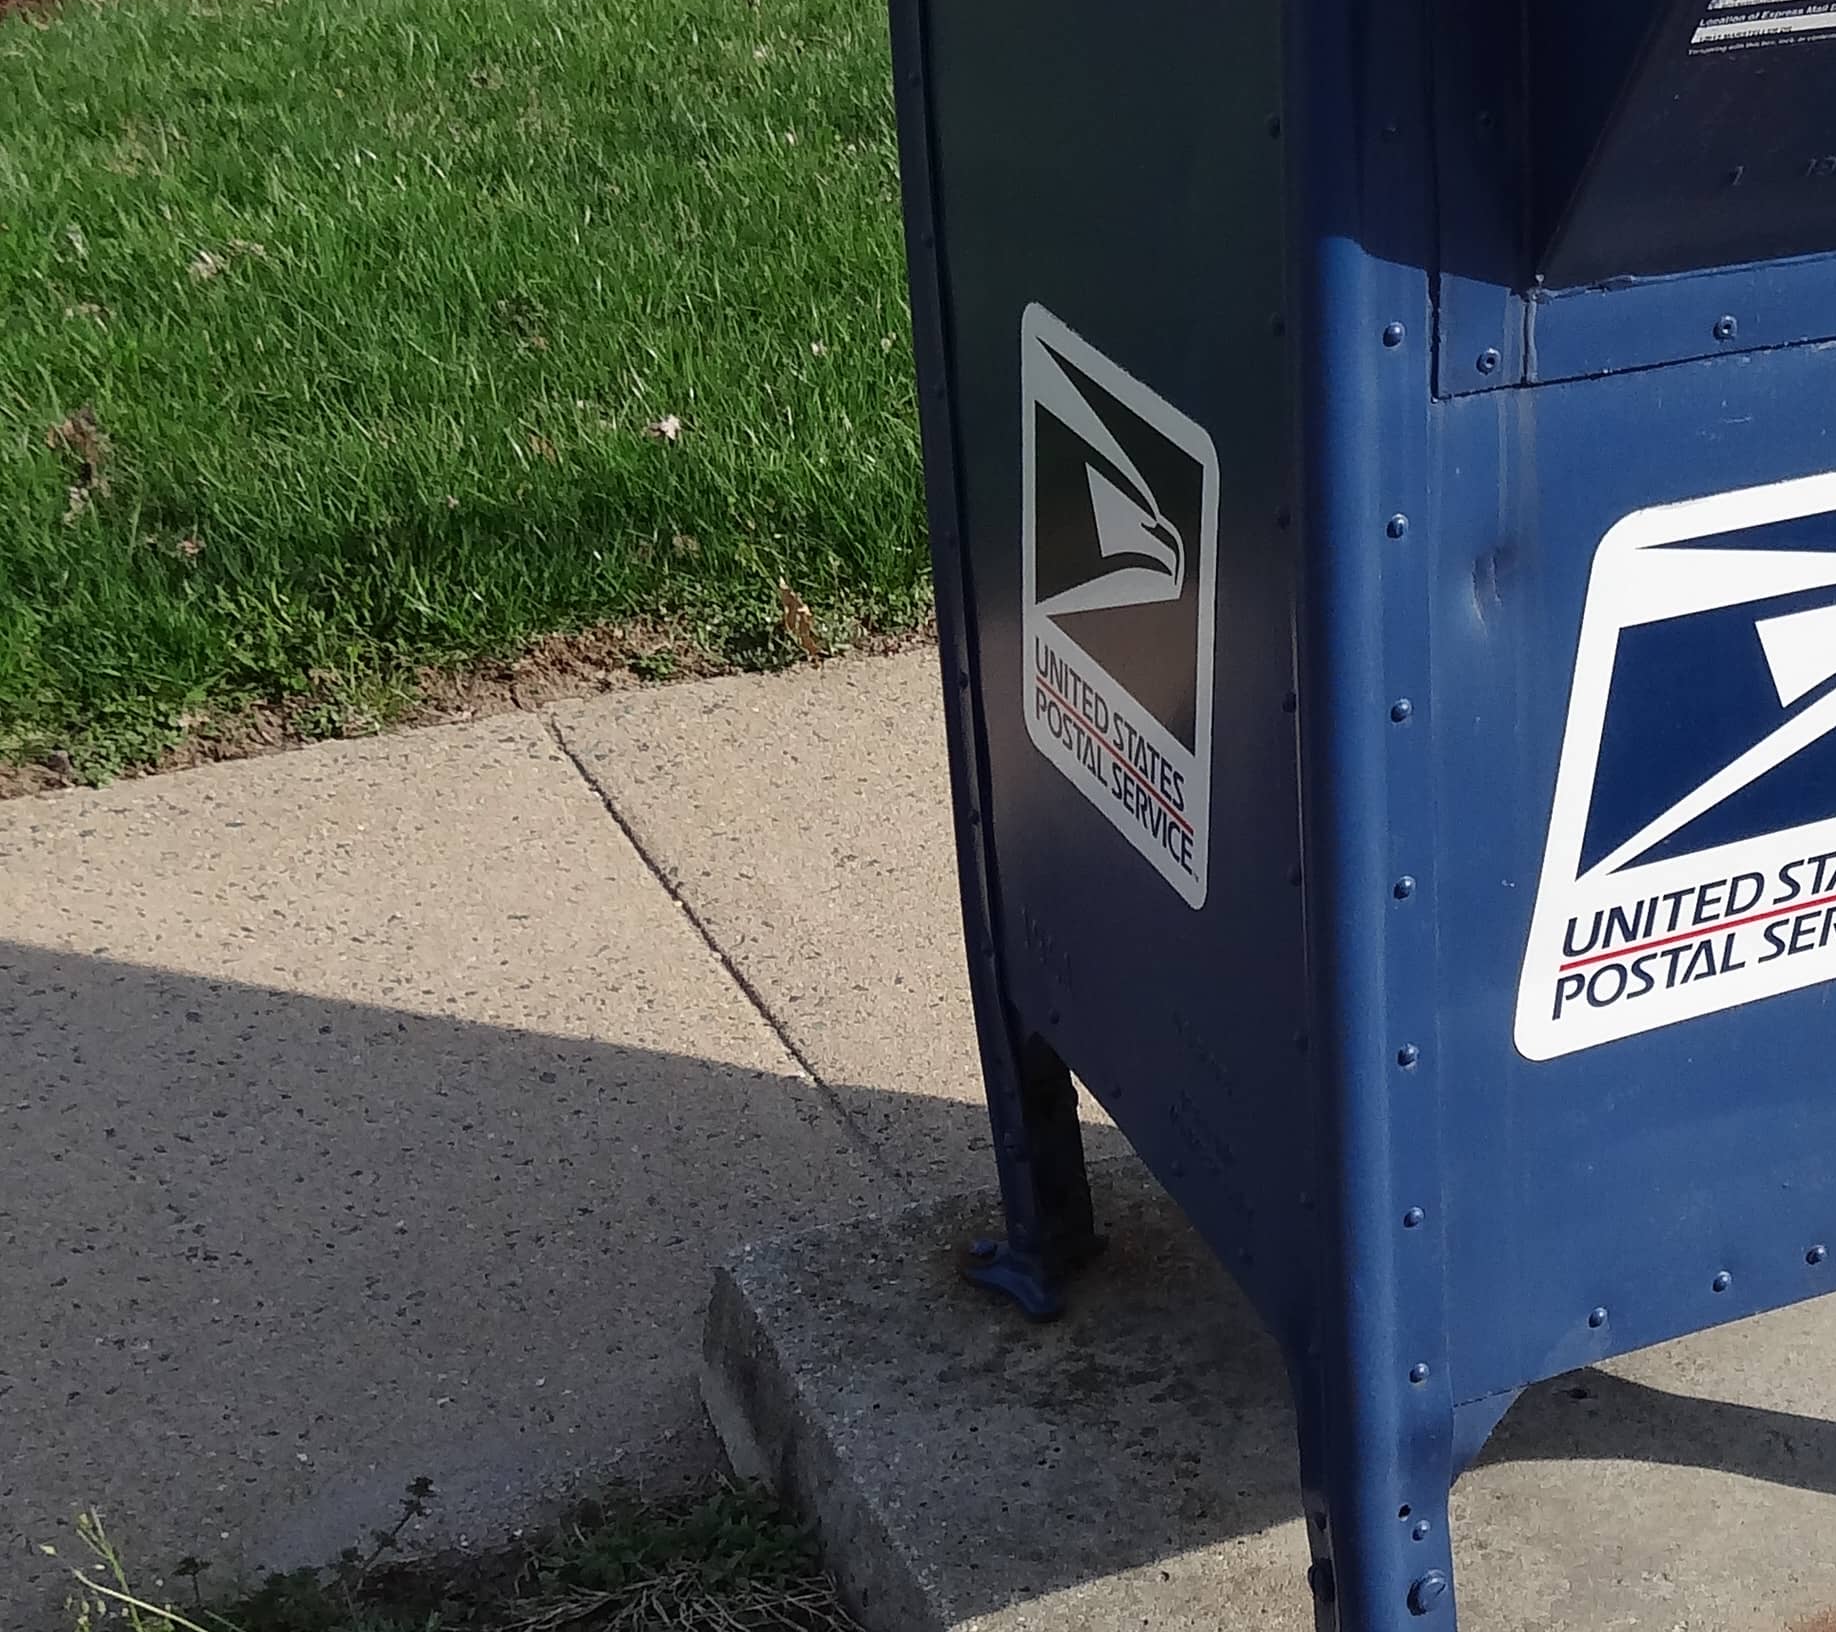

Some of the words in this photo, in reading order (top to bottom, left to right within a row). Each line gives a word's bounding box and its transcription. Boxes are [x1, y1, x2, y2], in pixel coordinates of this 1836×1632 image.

[1035, 635, 1109, 735] UNITED
[1113, 711, 1185, 812] STATES
[1035, 686, 1108, 788] POSTAL
[1111, 761, 1195, 876] SERVICE
[1552, 939, 1746, 1021] POSTAL
[1562, 871, 1765, 958] UNITED
